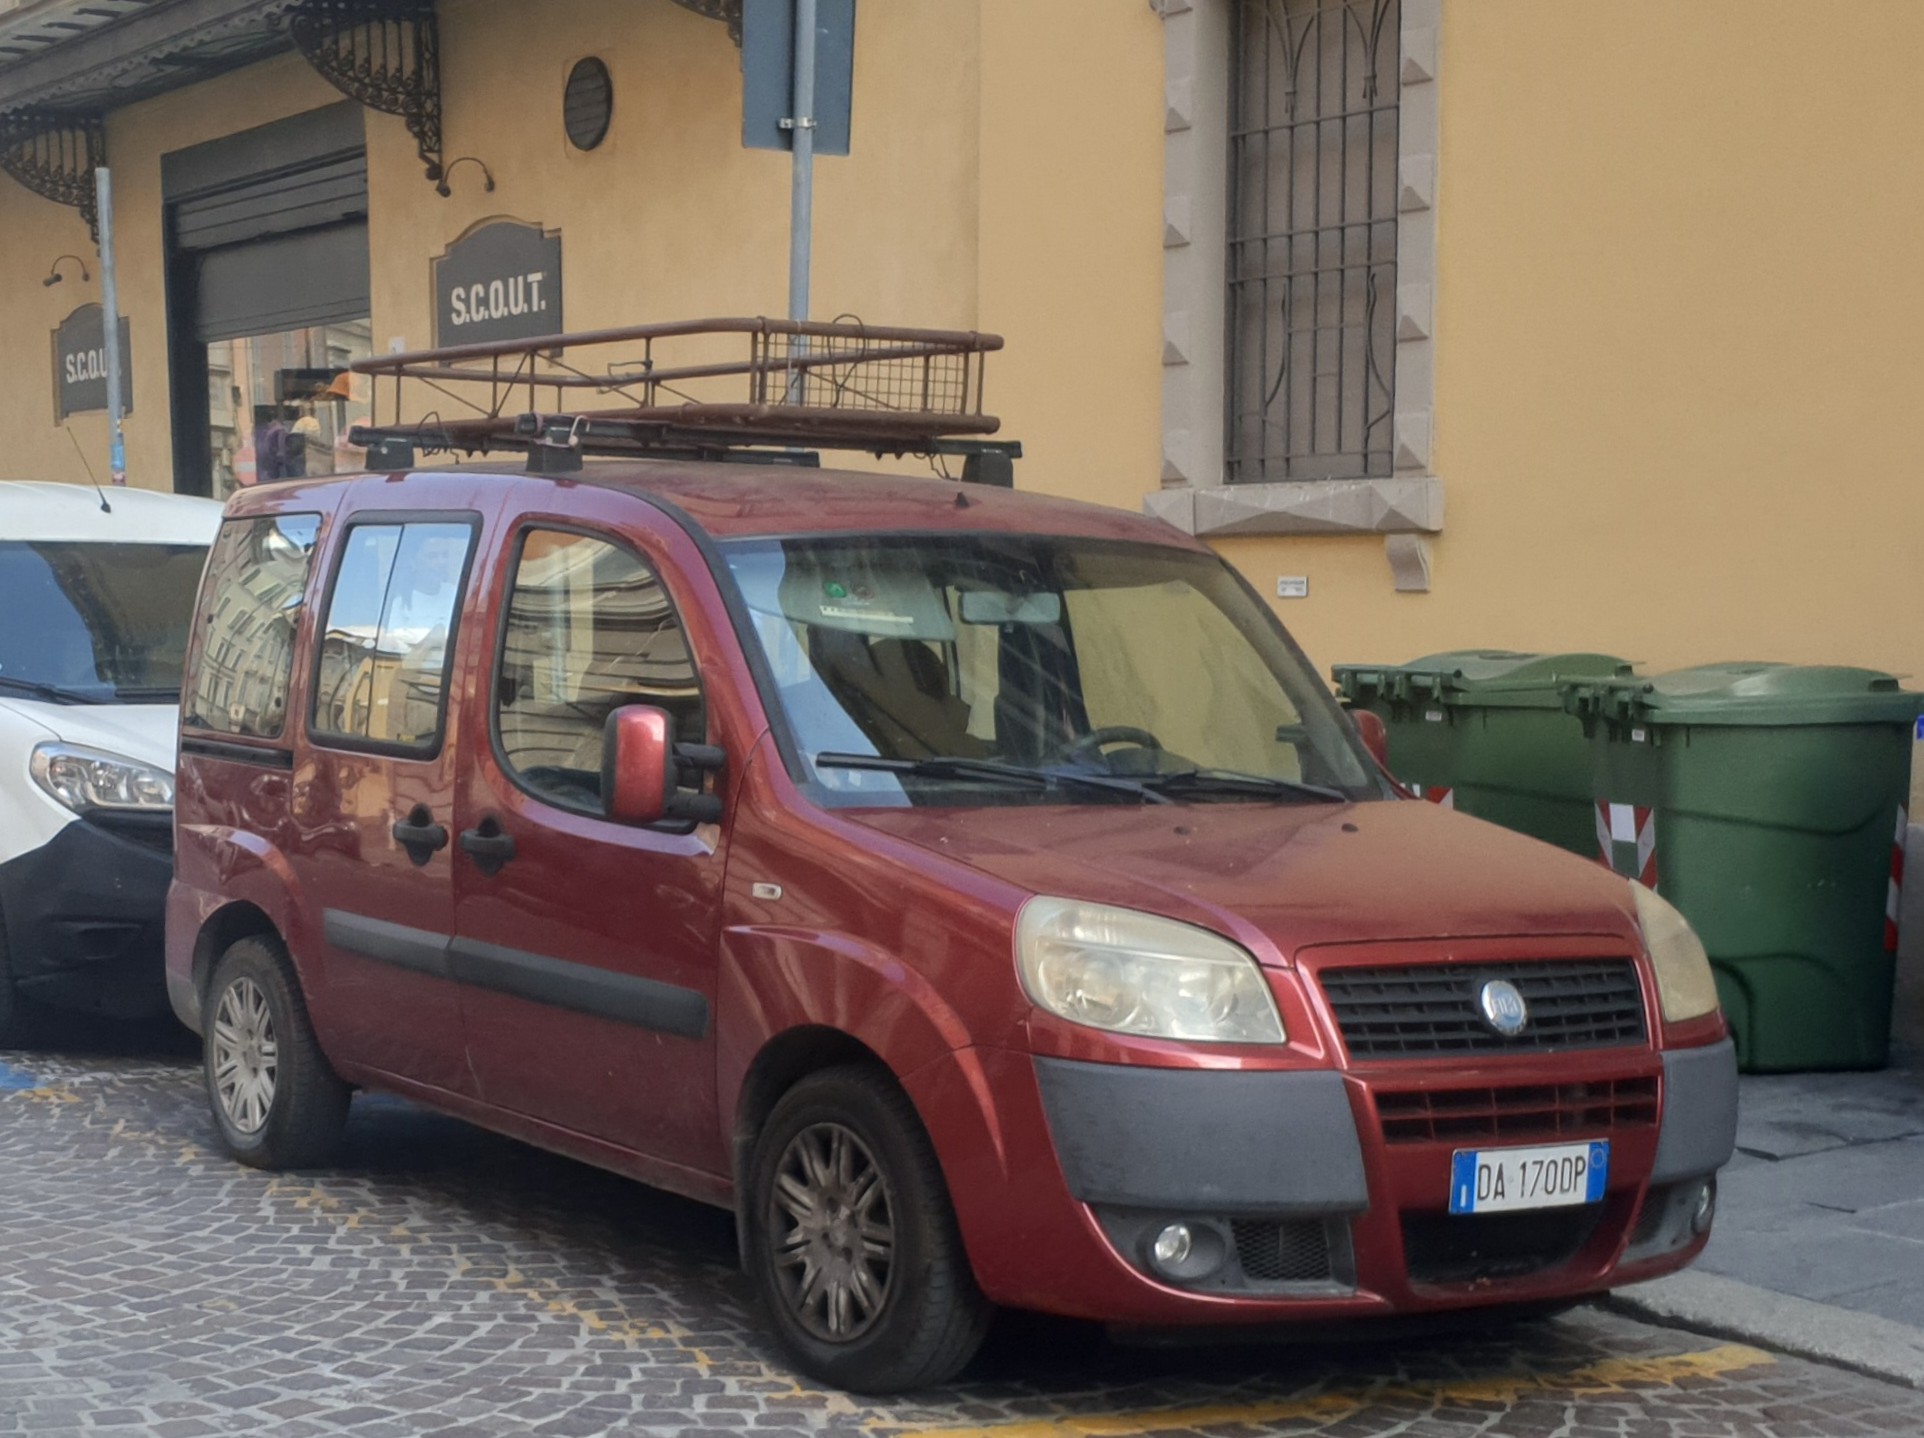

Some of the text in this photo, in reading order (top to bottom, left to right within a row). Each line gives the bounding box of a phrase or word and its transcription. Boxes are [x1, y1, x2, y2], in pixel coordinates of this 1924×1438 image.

[451, 271, 546, 326] S.C.O.U.T.
[1477, 1155, 1586, 1200] DA 170DP
